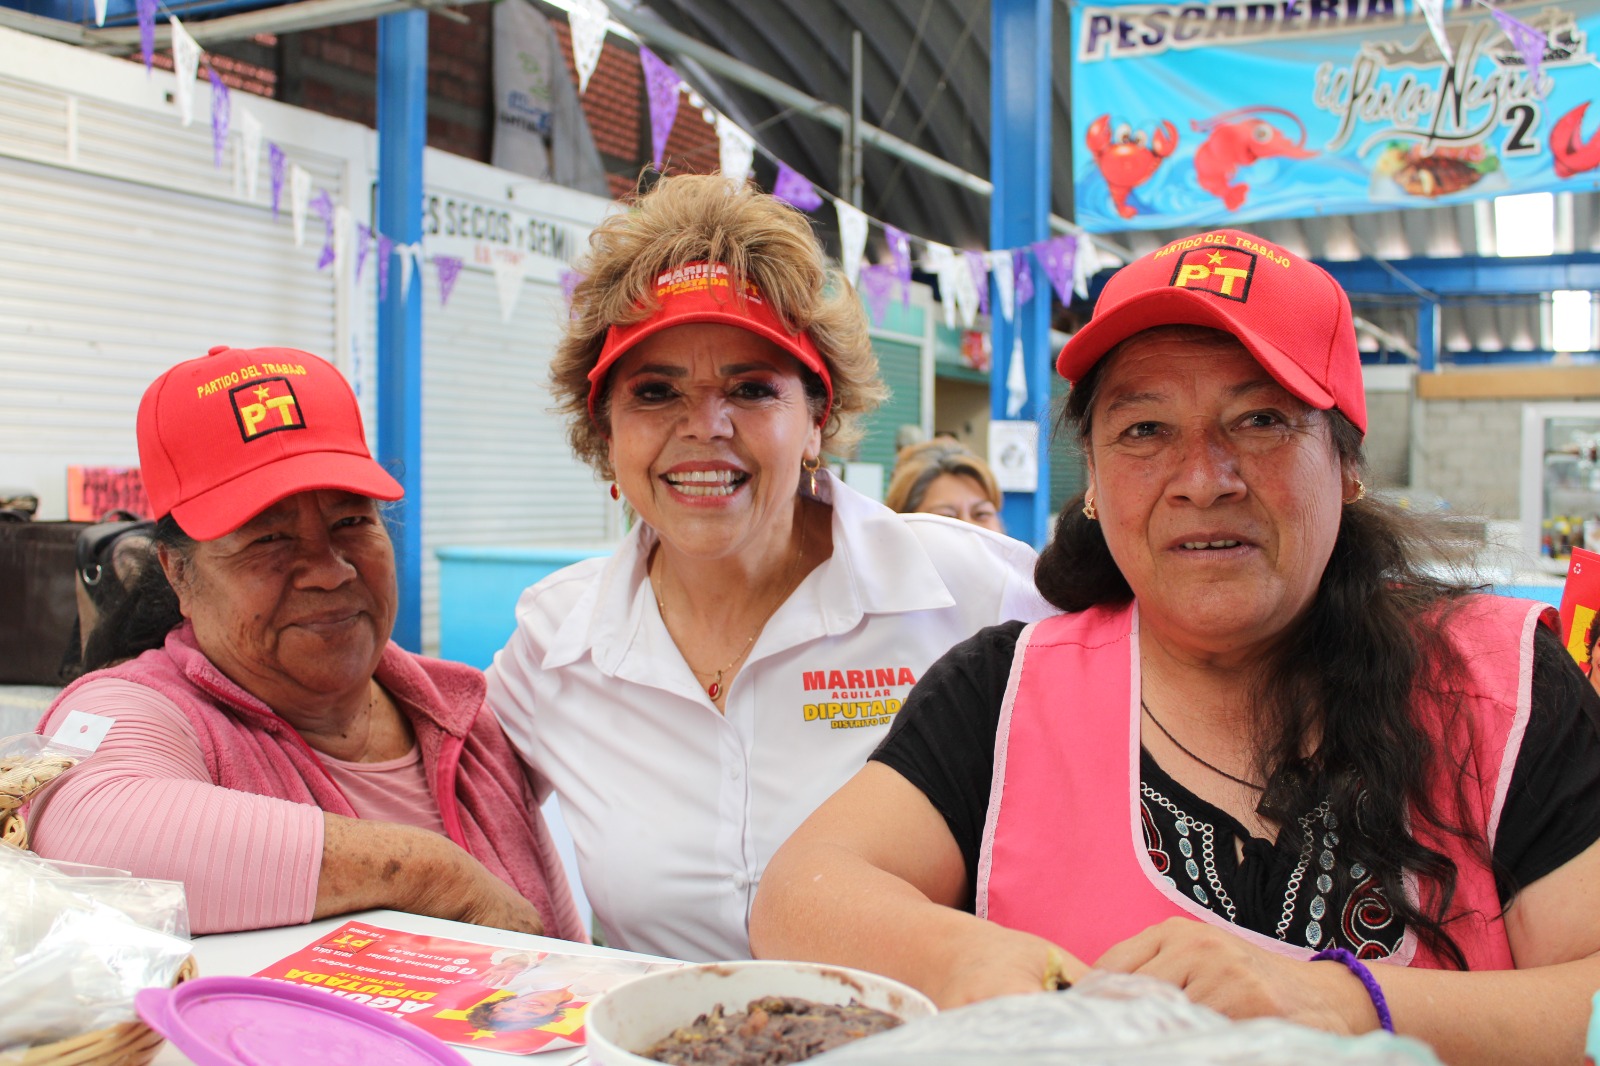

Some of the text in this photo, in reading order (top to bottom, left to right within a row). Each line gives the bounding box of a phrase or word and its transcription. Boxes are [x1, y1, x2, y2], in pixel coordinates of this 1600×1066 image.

[1504, 103, 1536, 152] 2
[446, 200, 510, 244] SECOS
[1154, 234, 1291, 268] PARTIDO DEL TRABAJO
[1175, 264, 1248, 296] PT
[197, 363, 307, 399] PARTIDO DEL TRABAJO
[241, 395, 296, 436] PT
[803, 667, 918, 691] MARINA
[832, 689, 891, 699] AGUILAR
[803, 698, 908, 721] DIPUTAD
[831, 716, 891, 729] DISTRITO IV
[333, 934, 373, 948] PT
[366, 952, 441, 970] Marina Aguilar
[284, 968, 438, 1000] DIPUTADA
[351, 974, 406, 987] DISTRITO
